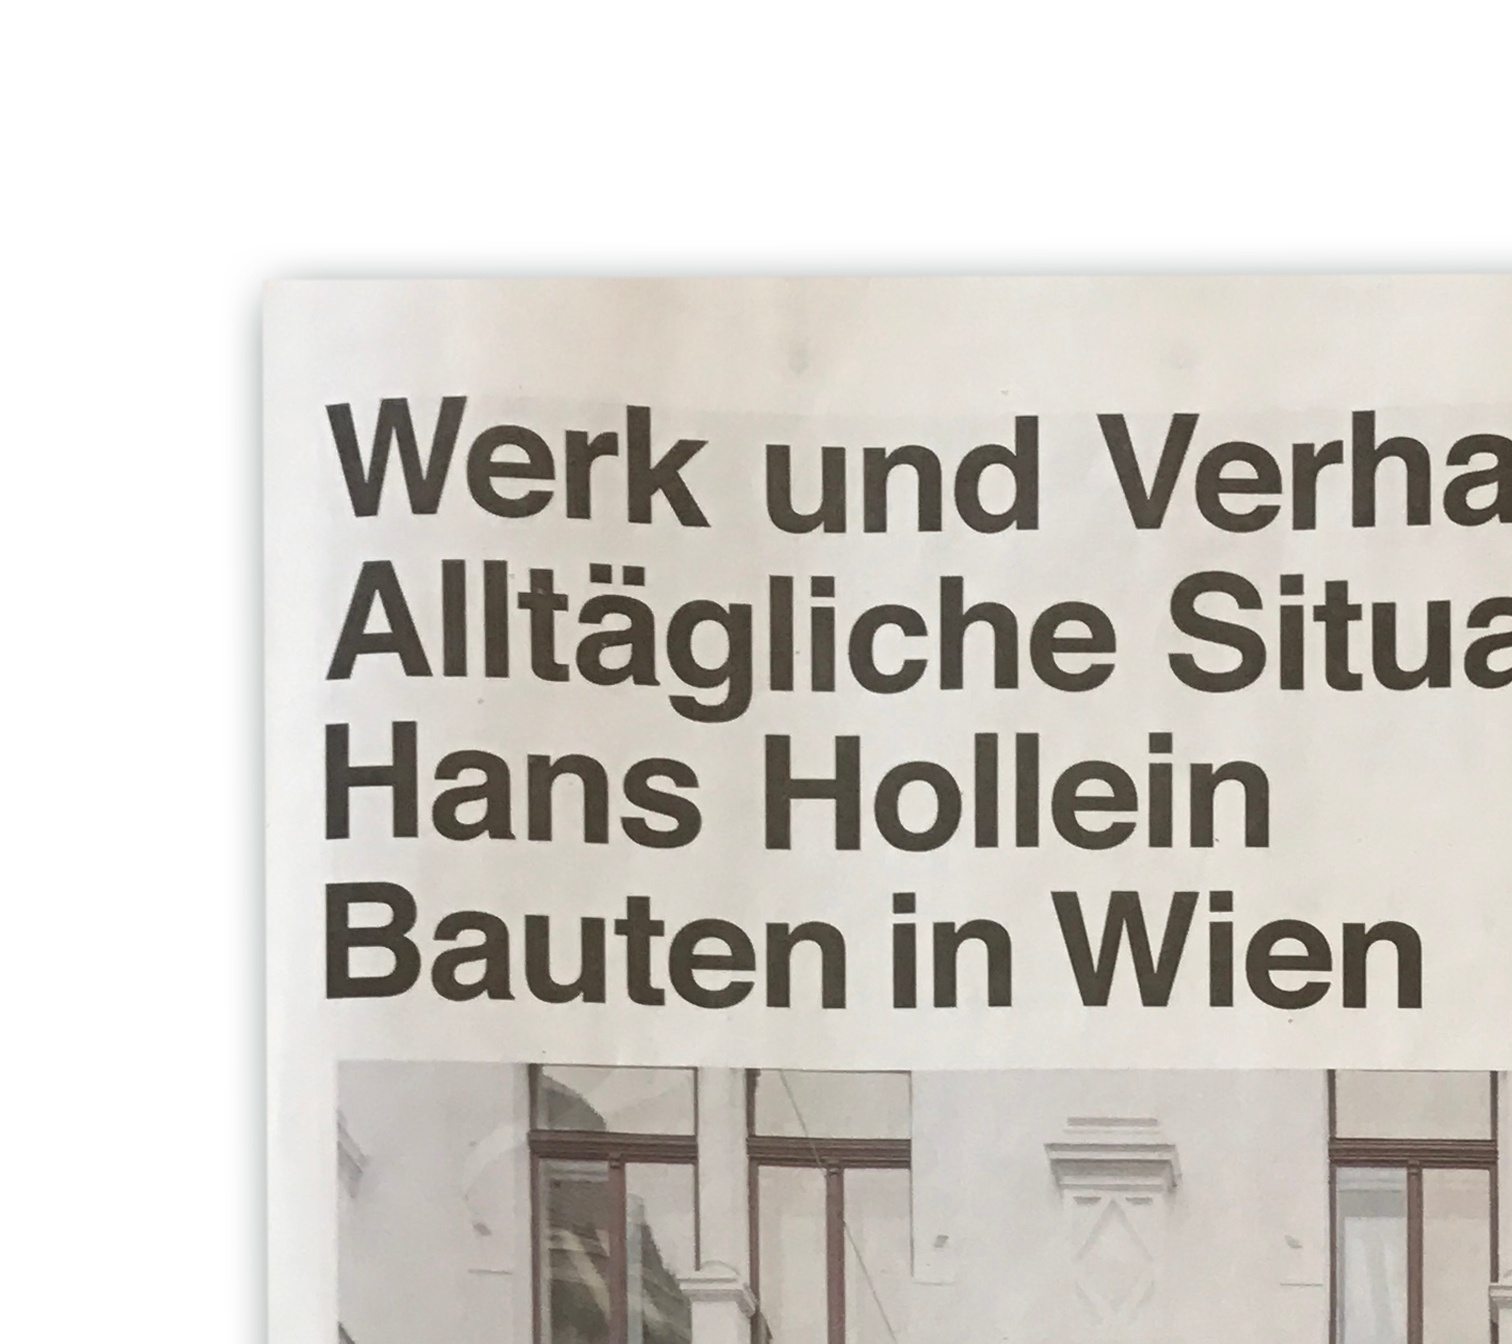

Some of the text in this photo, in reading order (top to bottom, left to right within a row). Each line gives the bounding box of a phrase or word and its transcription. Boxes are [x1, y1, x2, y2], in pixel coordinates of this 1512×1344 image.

[327, 397, 710, 527] Werk
[767, 416, 1038, 533] und
[327, 560, 1116, 723] Alltägliche
[326, 721, 1269, 851] Hans Hollein
[326, 882, 1421, 1009] Bauten in Wien
